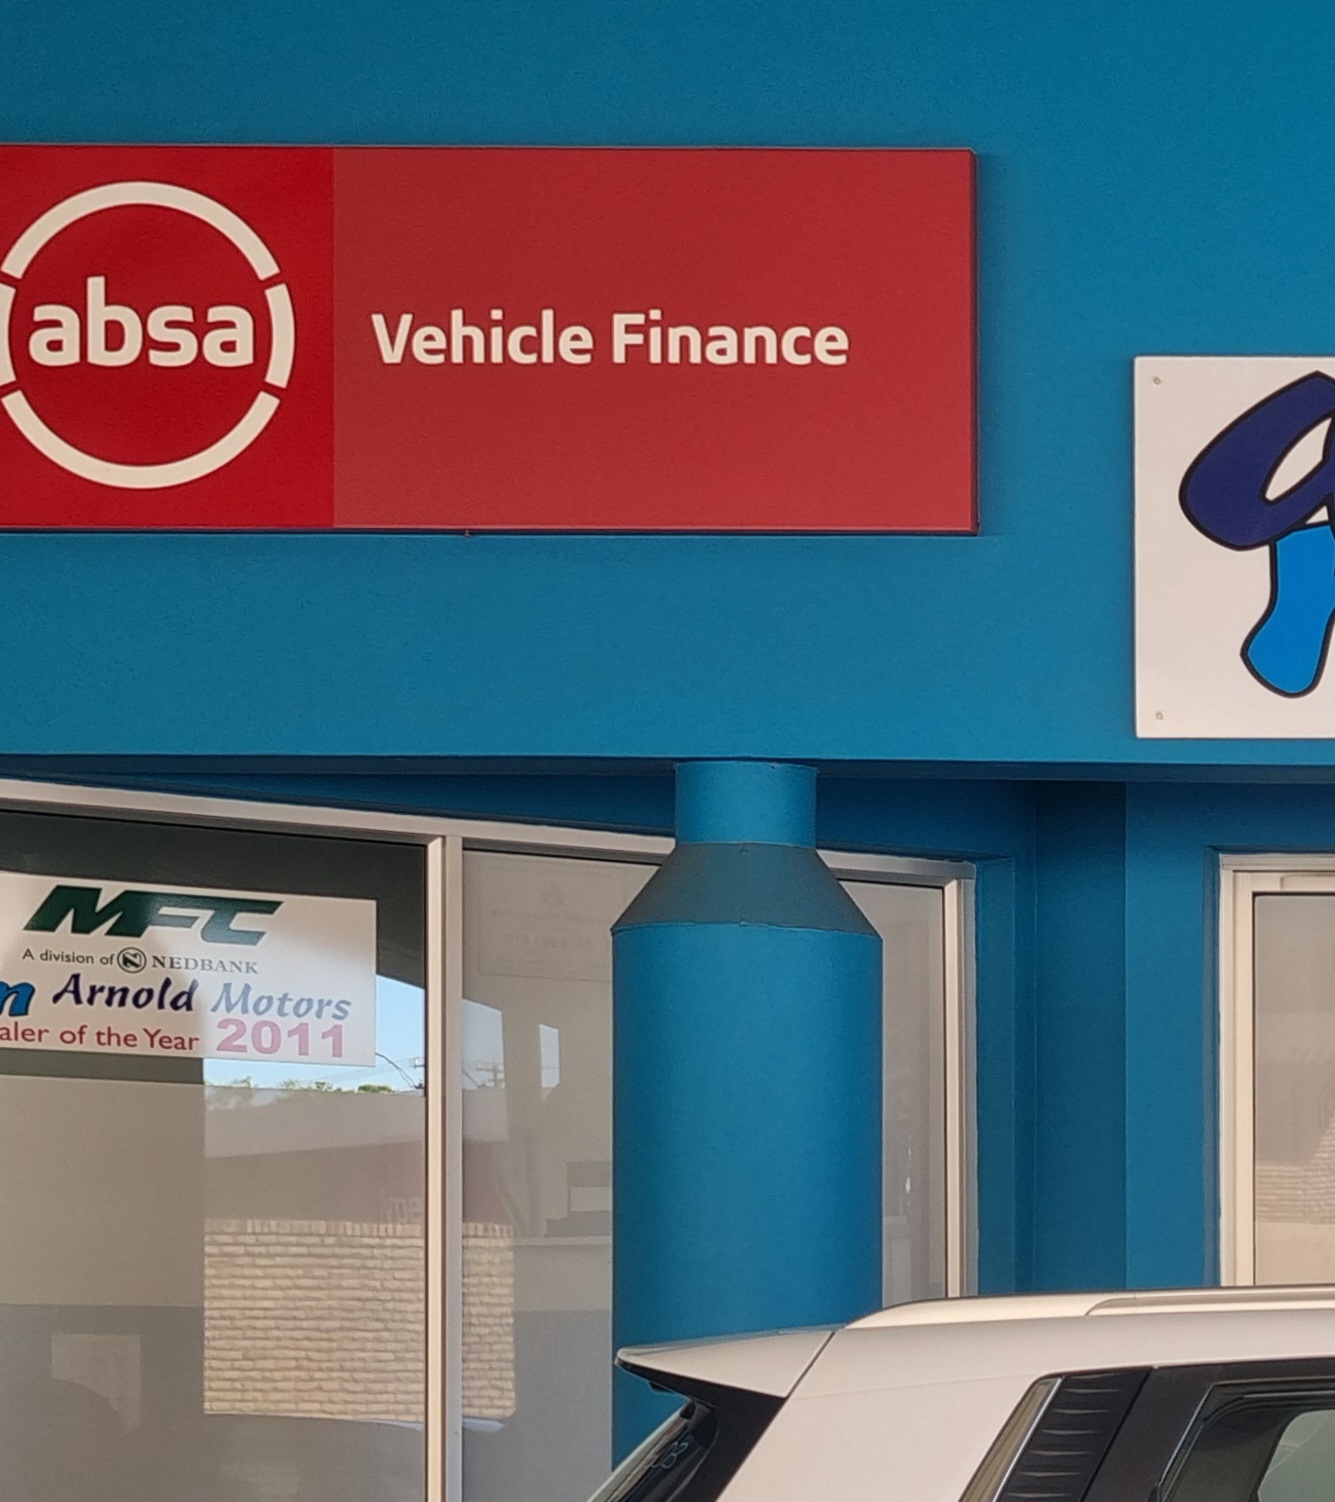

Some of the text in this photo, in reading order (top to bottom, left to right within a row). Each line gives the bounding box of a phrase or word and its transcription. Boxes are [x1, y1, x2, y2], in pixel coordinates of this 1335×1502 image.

[28, 275, 257, 368] absa
[371, 308, 849, 366] Vehicle Finance
[23, 885, 284, 946] MFC
[22, 949, 259, 974] A division of NEDBANK
[52, 972, 200, 1011] Arnold
[210, 982, 352, 1021] Motors
[59, 1024, 88, 1045] of
[95, 1026, 138, 1047] the
[143, 1027, 200, 1051] Year
[216, 1018, 344, 1058] 2011
